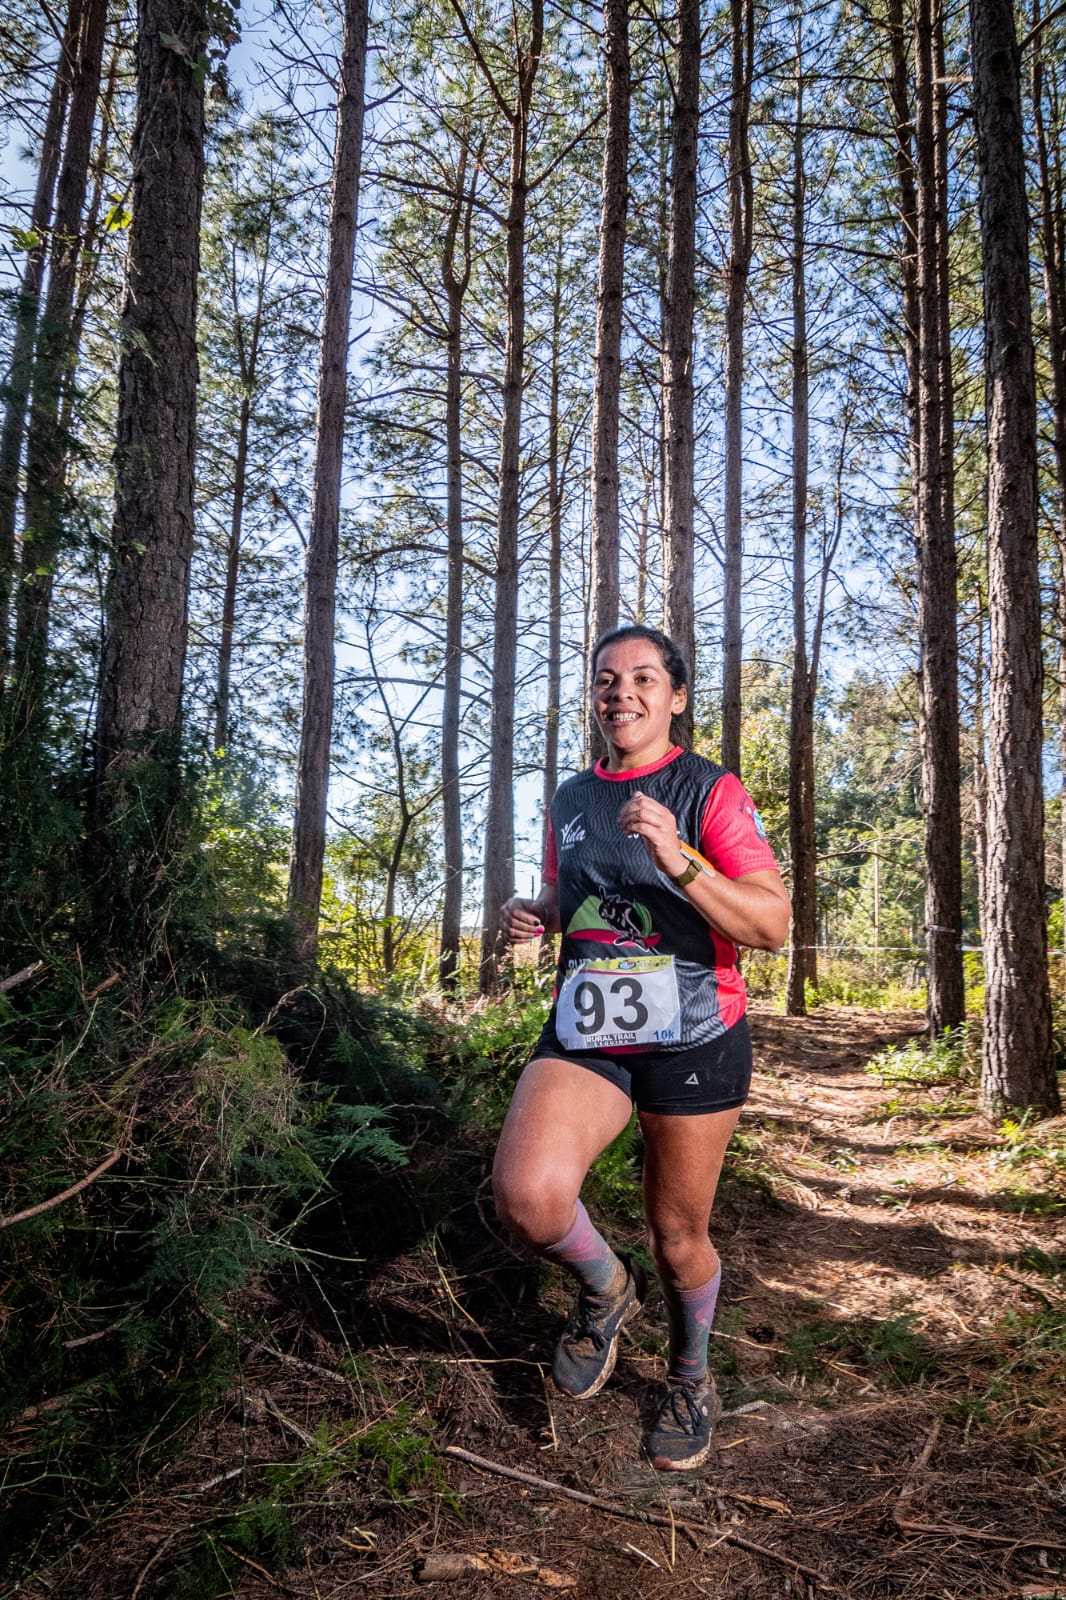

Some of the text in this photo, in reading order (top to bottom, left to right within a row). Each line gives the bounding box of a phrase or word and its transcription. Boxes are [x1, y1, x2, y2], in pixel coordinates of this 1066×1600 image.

[574, 977, 648, 1035] 93
[586, 1033, 636, 1042] RURAL TRAIL
